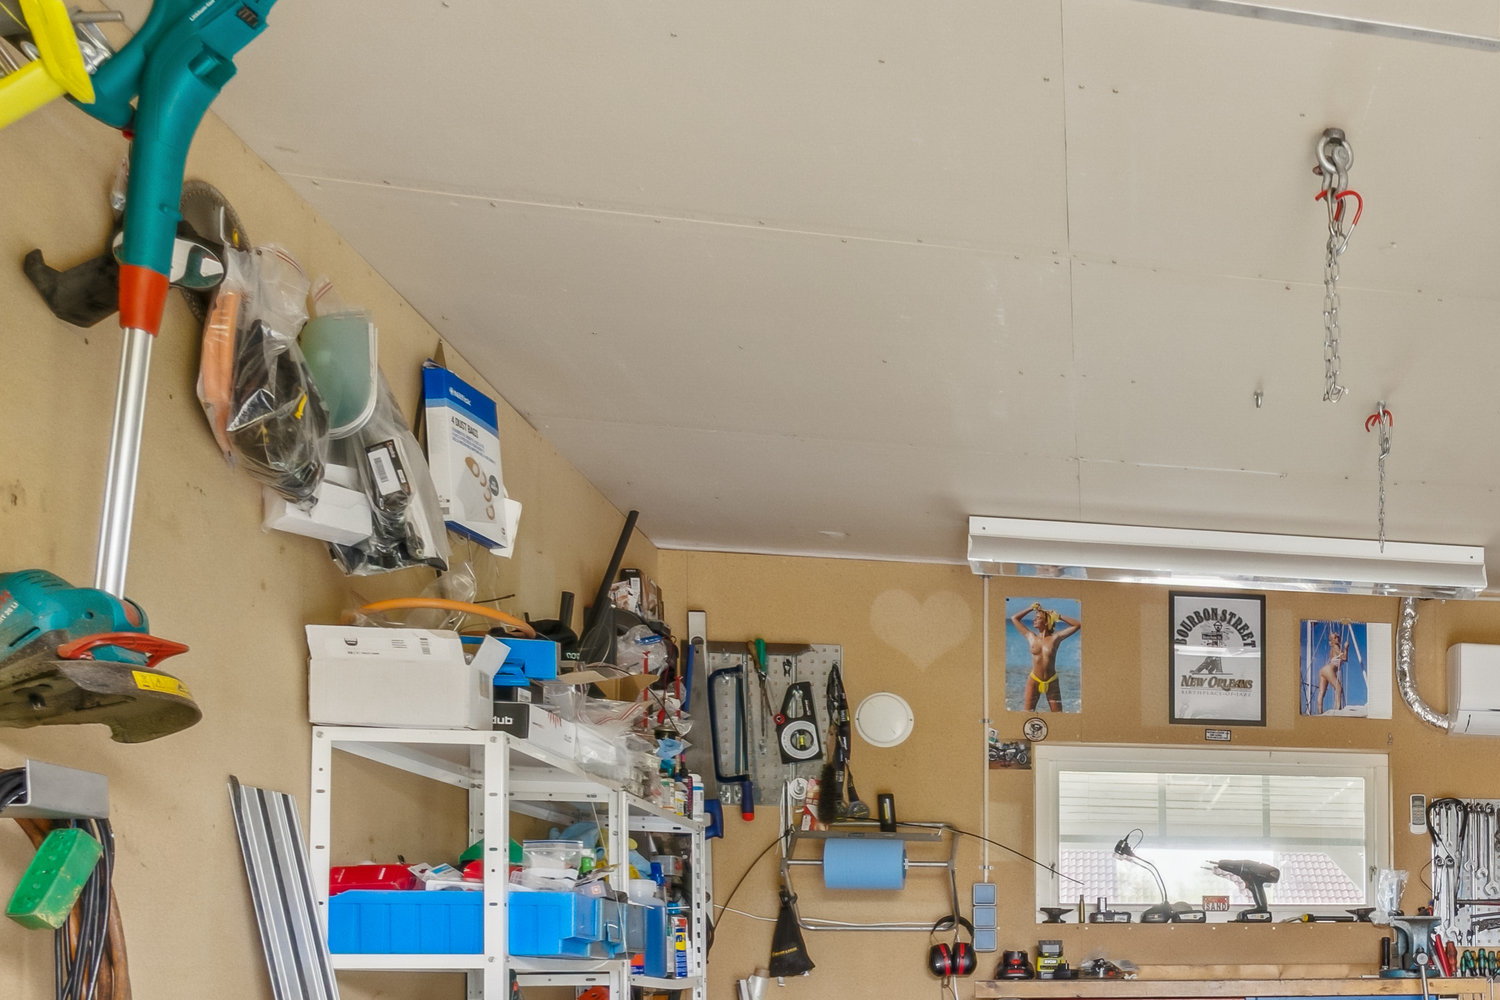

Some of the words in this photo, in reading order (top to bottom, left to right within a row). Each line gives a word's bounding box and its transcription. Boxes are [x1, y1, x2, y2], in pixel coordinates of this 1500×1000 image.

[1174, 607, 1218, 646] BOURBON
[1219, 609, 1257, 648] STREET
[1180, 674, 1208, 688] NEW
[1208, 676, 1254, 692] ORLEANS
